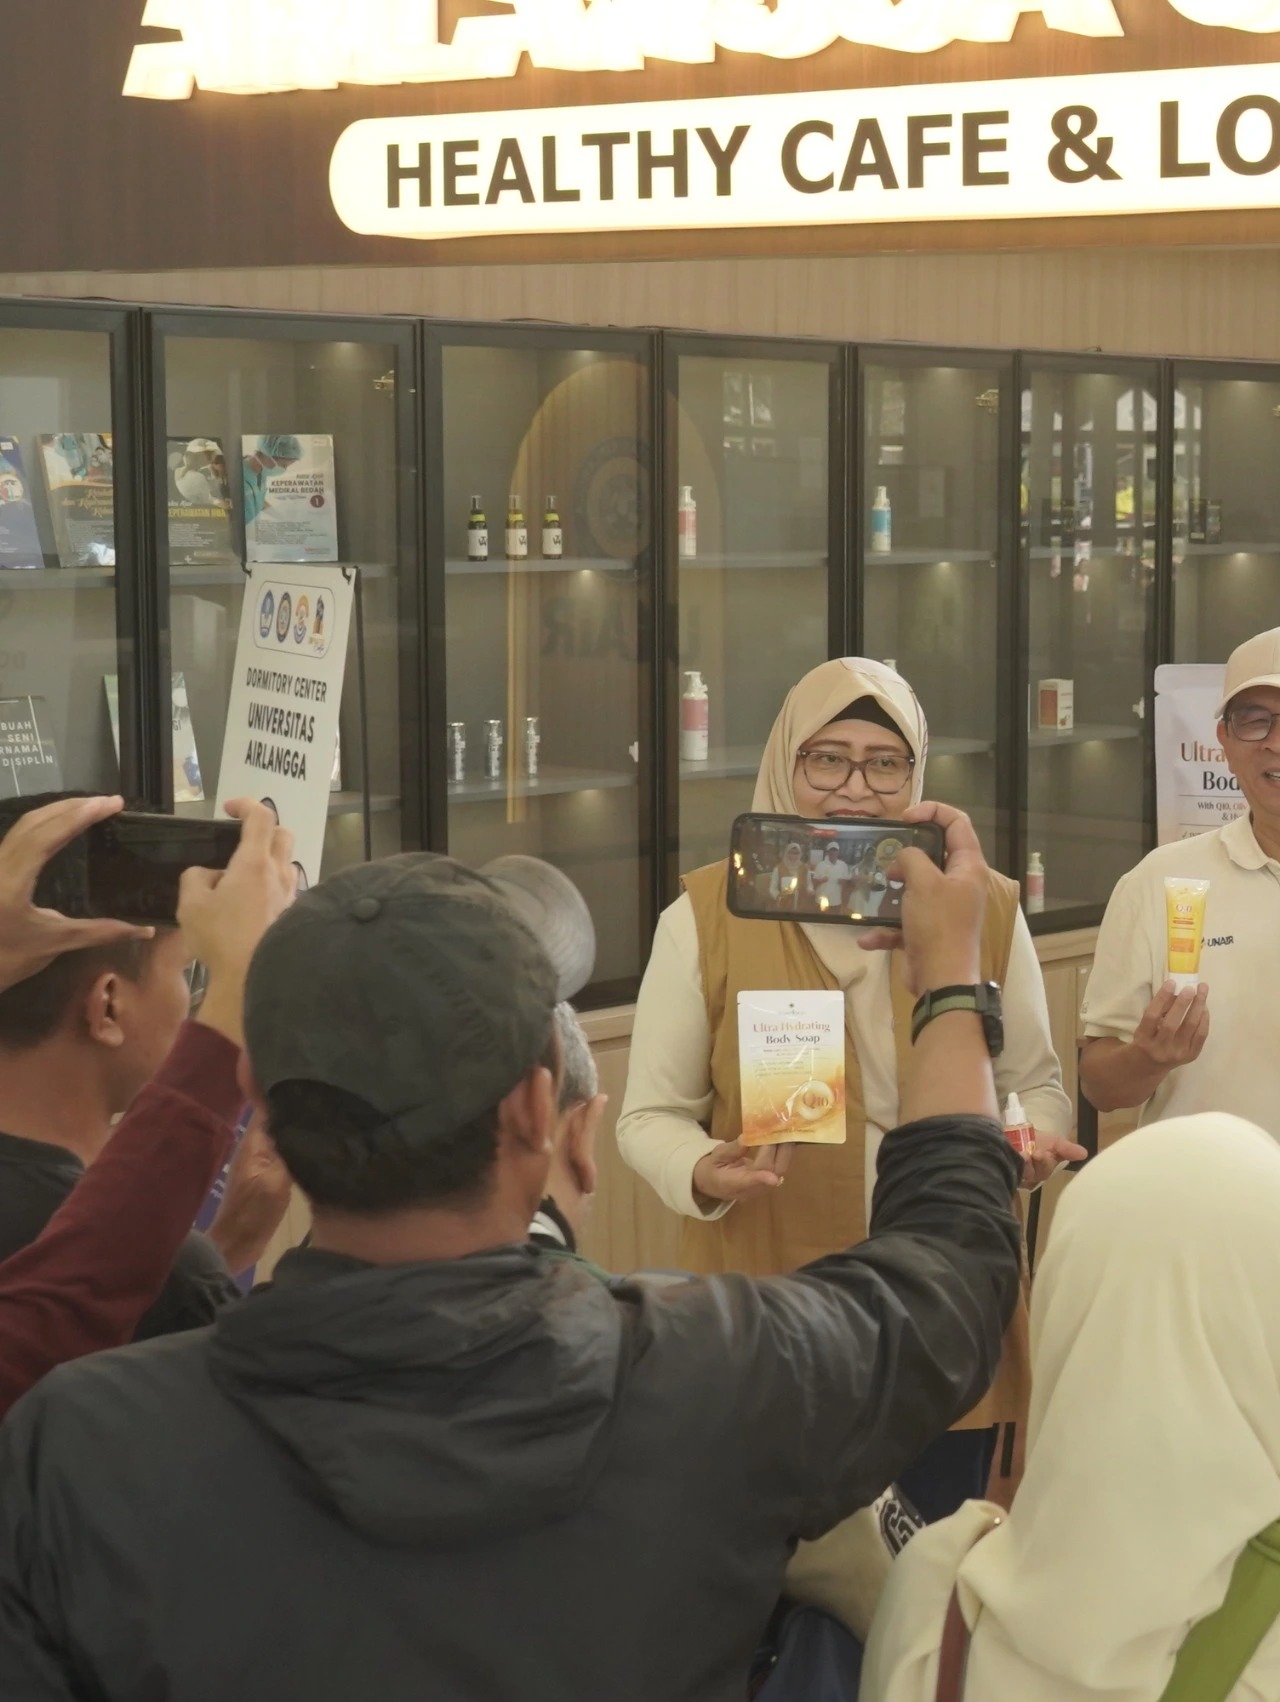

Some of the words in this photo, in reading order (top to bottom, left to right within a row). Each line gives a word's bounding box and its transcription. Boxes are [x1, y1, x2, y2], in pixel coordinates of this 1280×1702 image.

[386, 125, 752, 209] HEALTHY
[781, 110, 1010, 194] CAFE
[1047, 105, 1122, 184] &
[300, 487, 324, 495] BEDAH
[246, 667, 293, 696] DORMITORY
[294, 676, 328, 703] CENTER
[0, 721, 32, 731] BUAH
[247, 702, 315, 744] UNIVERSITAS
[7, 733, 34, 743] SENI
[1181, 741, 1225, 762] Ultra
[2, 755, 54, 767] DISIPLIN
[244, 739, 307, 781] AIRLANGGA
[1203, 771, 1240, 791] Bod
[1198, 802, 1214, 810] With
[1207, 935, 1234, 948] UNAIR
[753, 1022, 779, 1033] Ultra
[766, 1034, 791, 1045] Body
[795, 1033, 821, 1045] Soap
[803, 1091, 829, 1109] Q10
